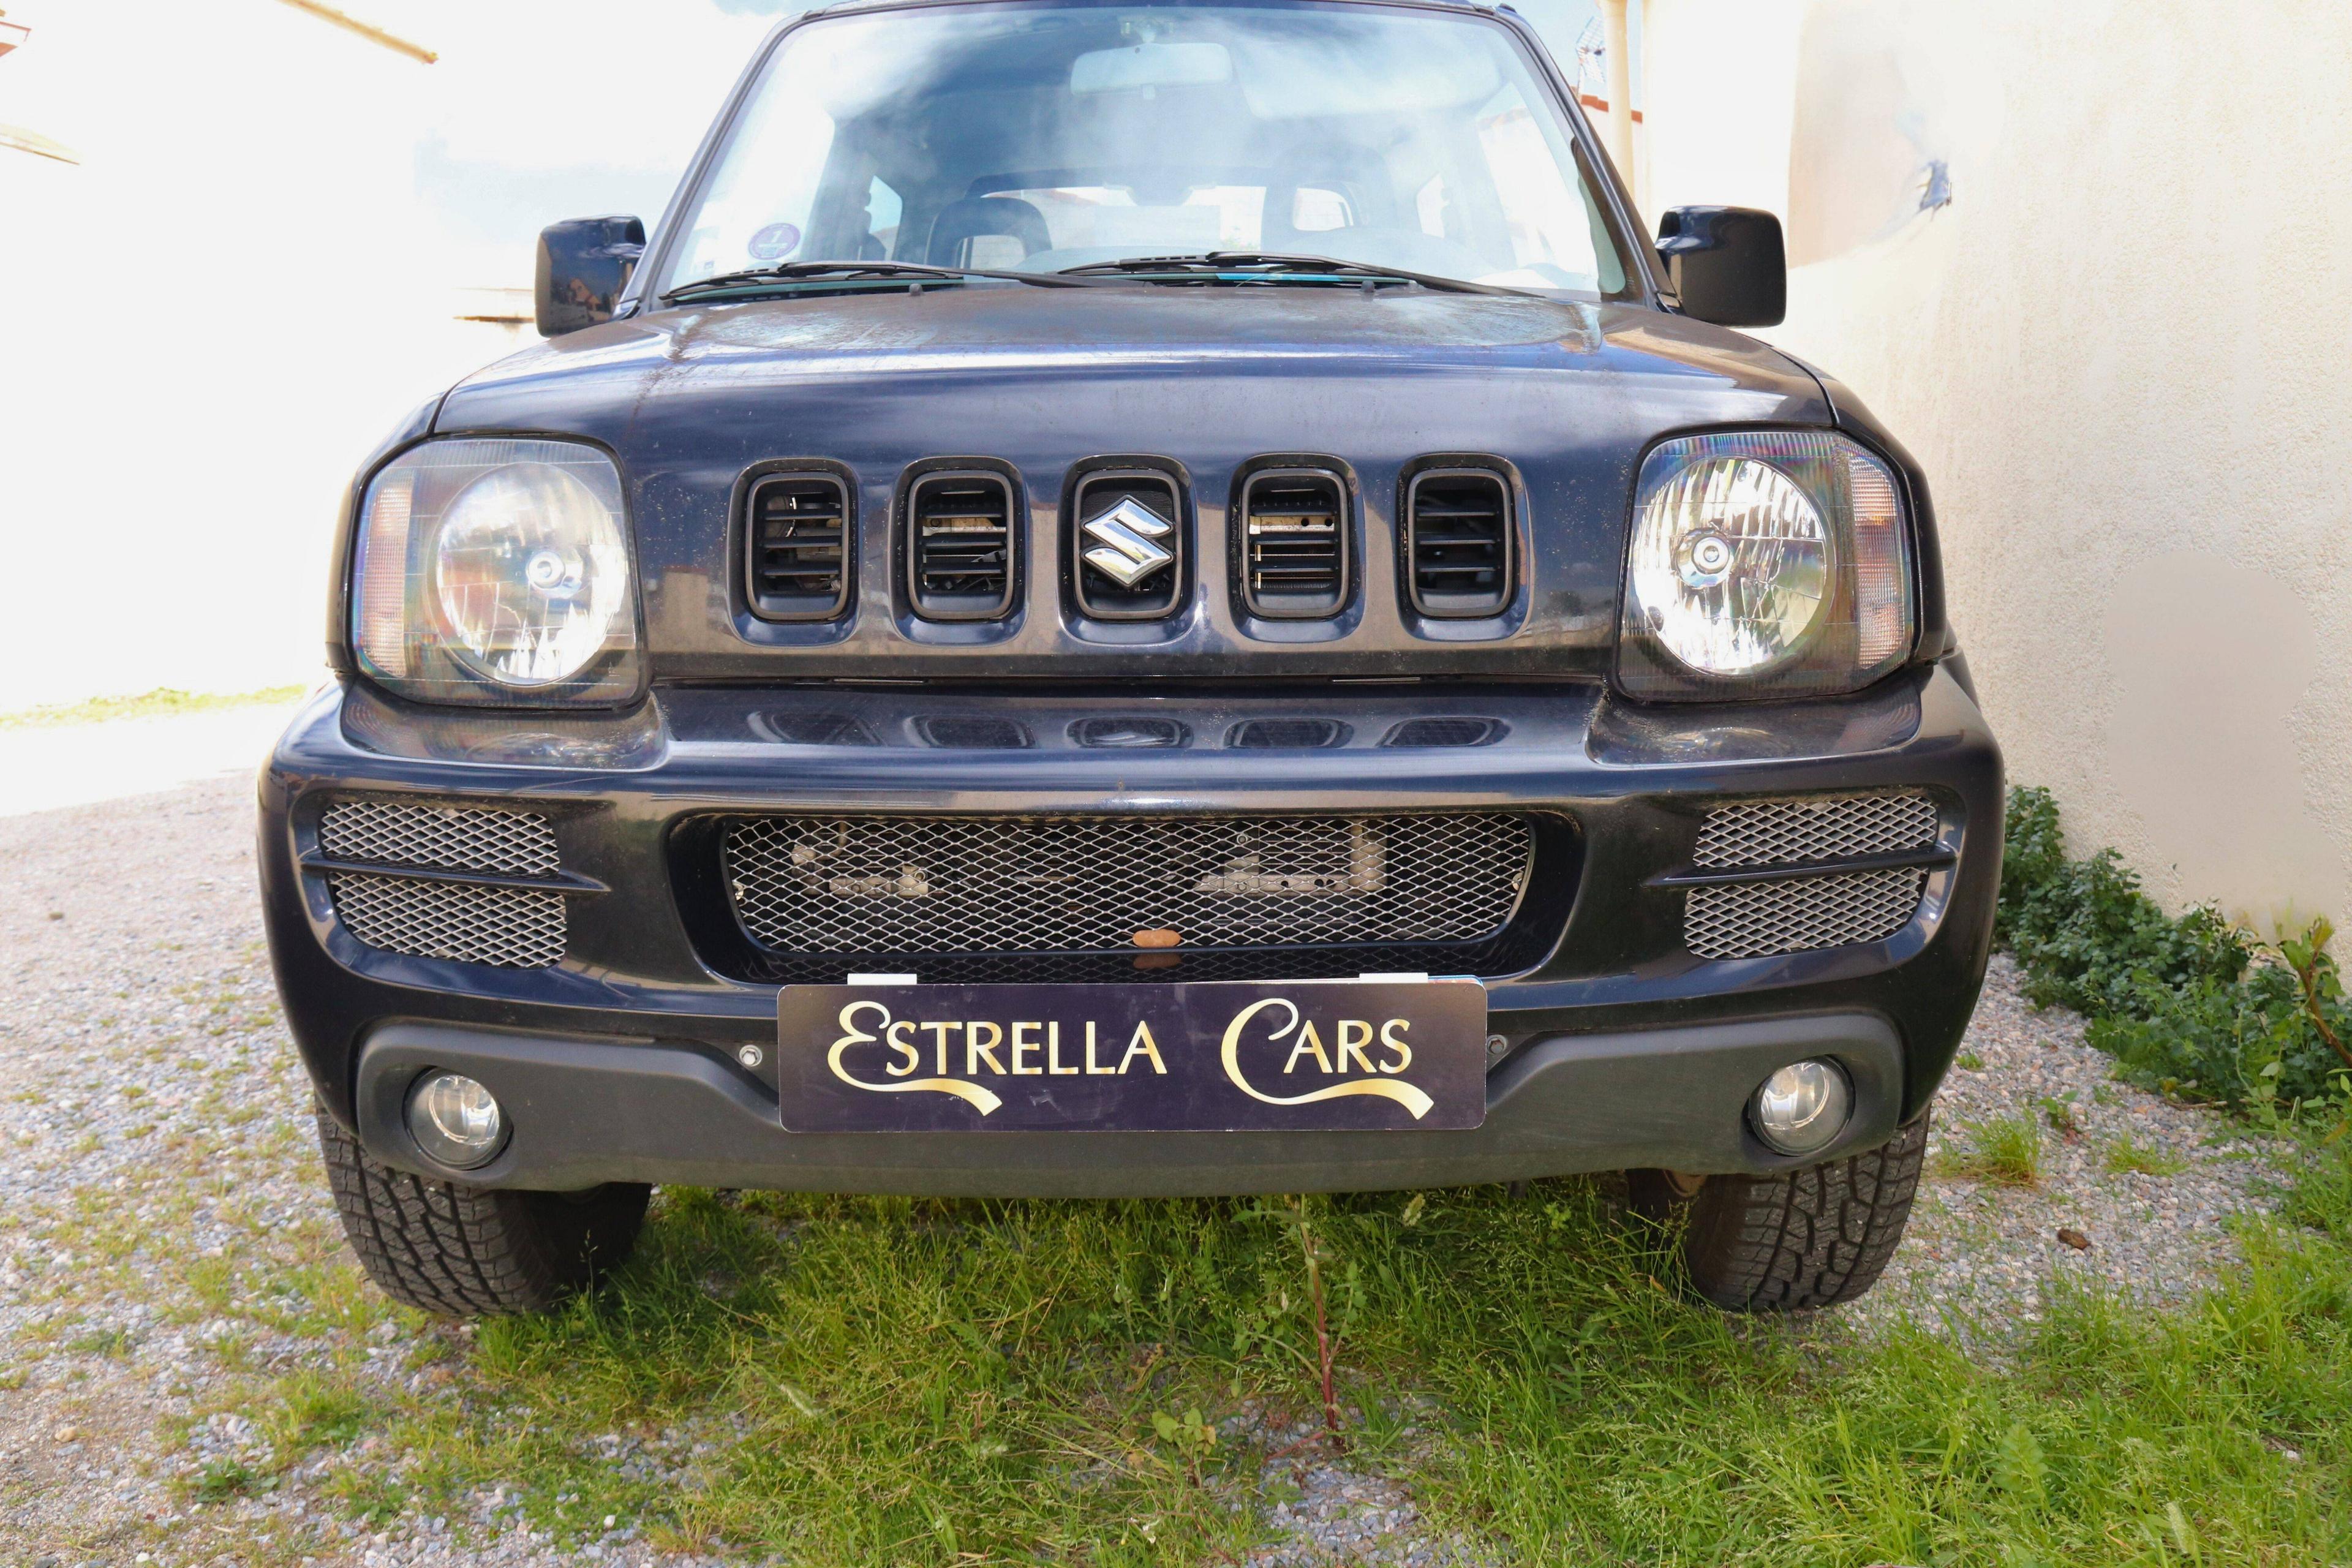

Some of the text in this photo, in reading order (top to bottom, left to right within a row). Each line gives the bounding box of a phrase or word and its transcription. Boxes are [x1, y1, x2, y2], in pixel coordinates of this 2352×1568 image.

[771, 230, 783, 243] 1
[827, 998, 1434, 1120] ESTRELLA CARS
